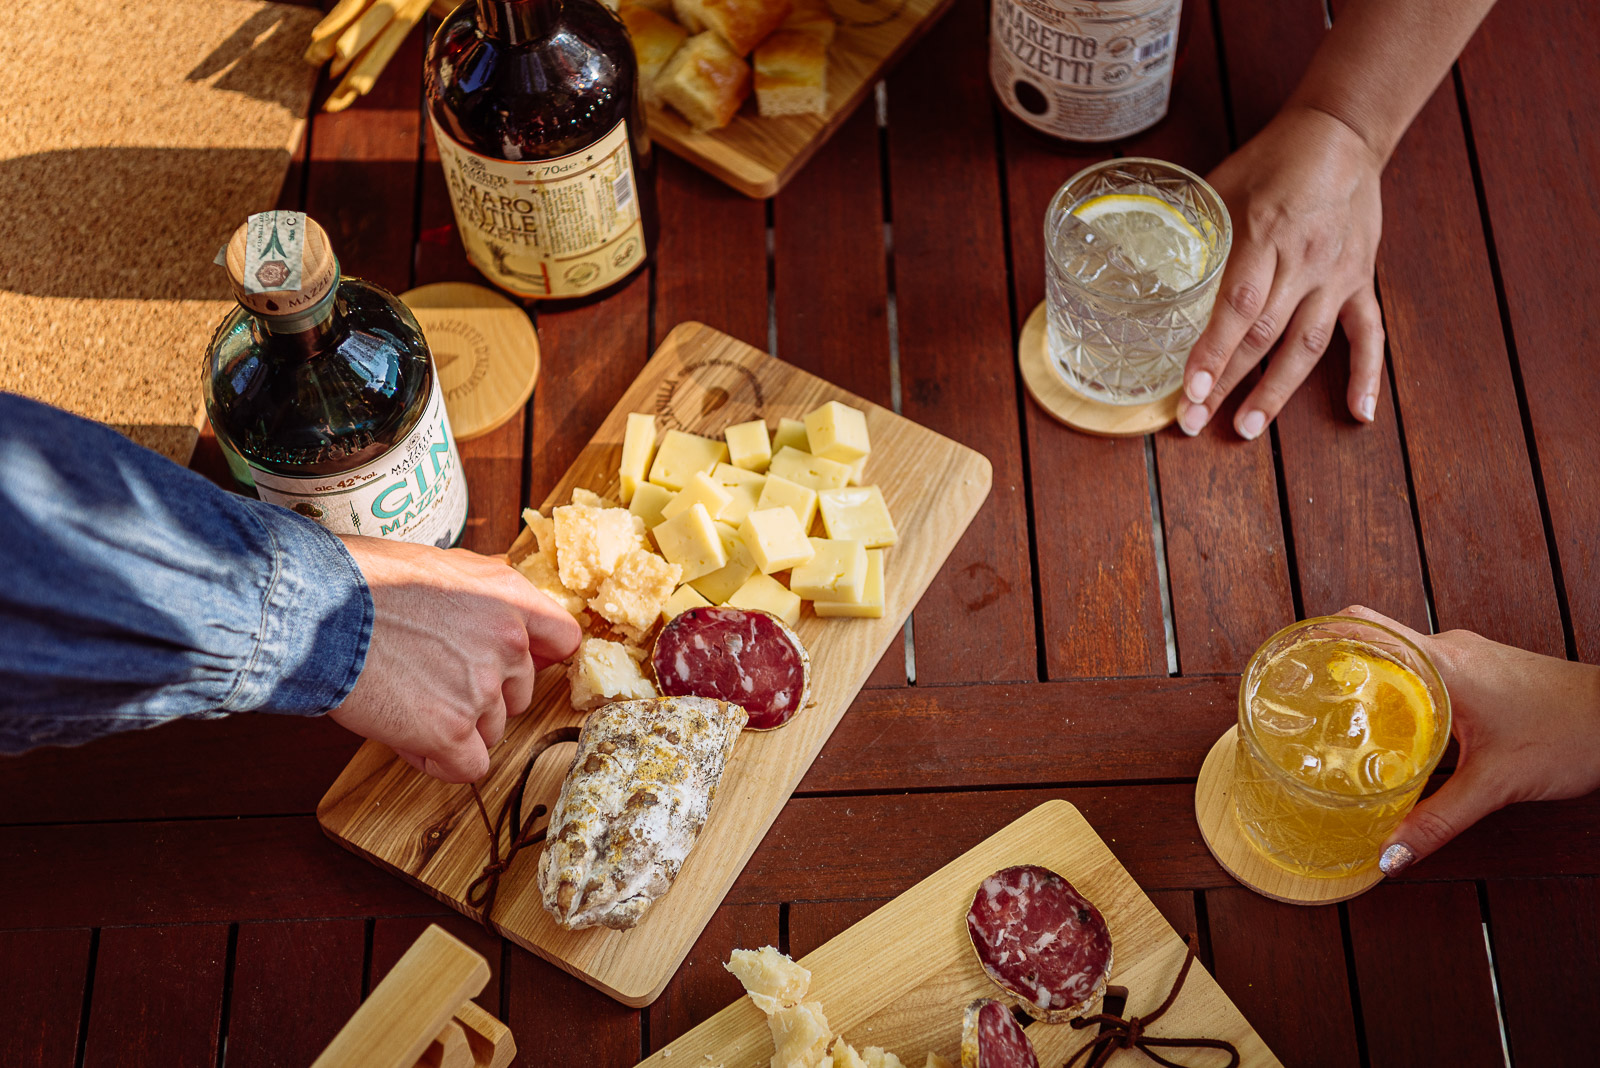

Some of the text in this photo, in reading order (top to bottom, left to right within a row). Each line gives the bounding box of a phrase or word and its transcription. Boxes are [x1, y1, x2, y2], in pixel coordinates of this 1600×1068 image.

[360, 471, 378, 482] vol.
[371, 418, 449, 519] GIN
[391, 424, 433, 475] MAZZETTI
[380, 447, 455, 536] MAZZETTI
